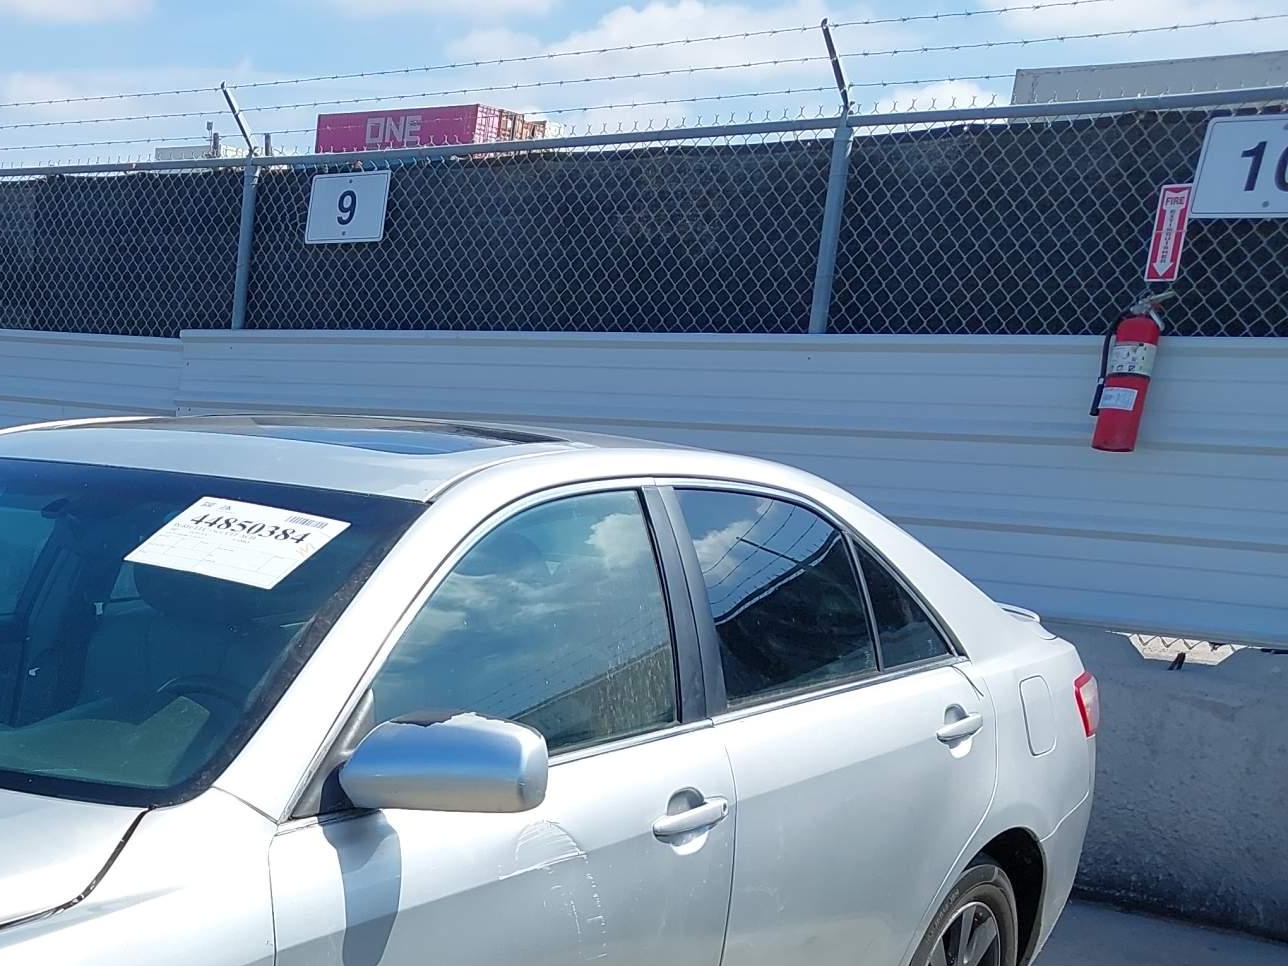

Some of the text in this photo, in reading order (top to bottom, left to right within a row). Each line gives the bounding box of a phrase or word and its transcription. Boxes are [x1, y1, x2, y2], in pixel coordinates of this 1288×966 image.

[365, 115, 422, 144] ONE
[337, 190, 357, 226] 9
[1165, 196, 1185, 206] FIRE
[190, 513, 312, 544] 44850384
